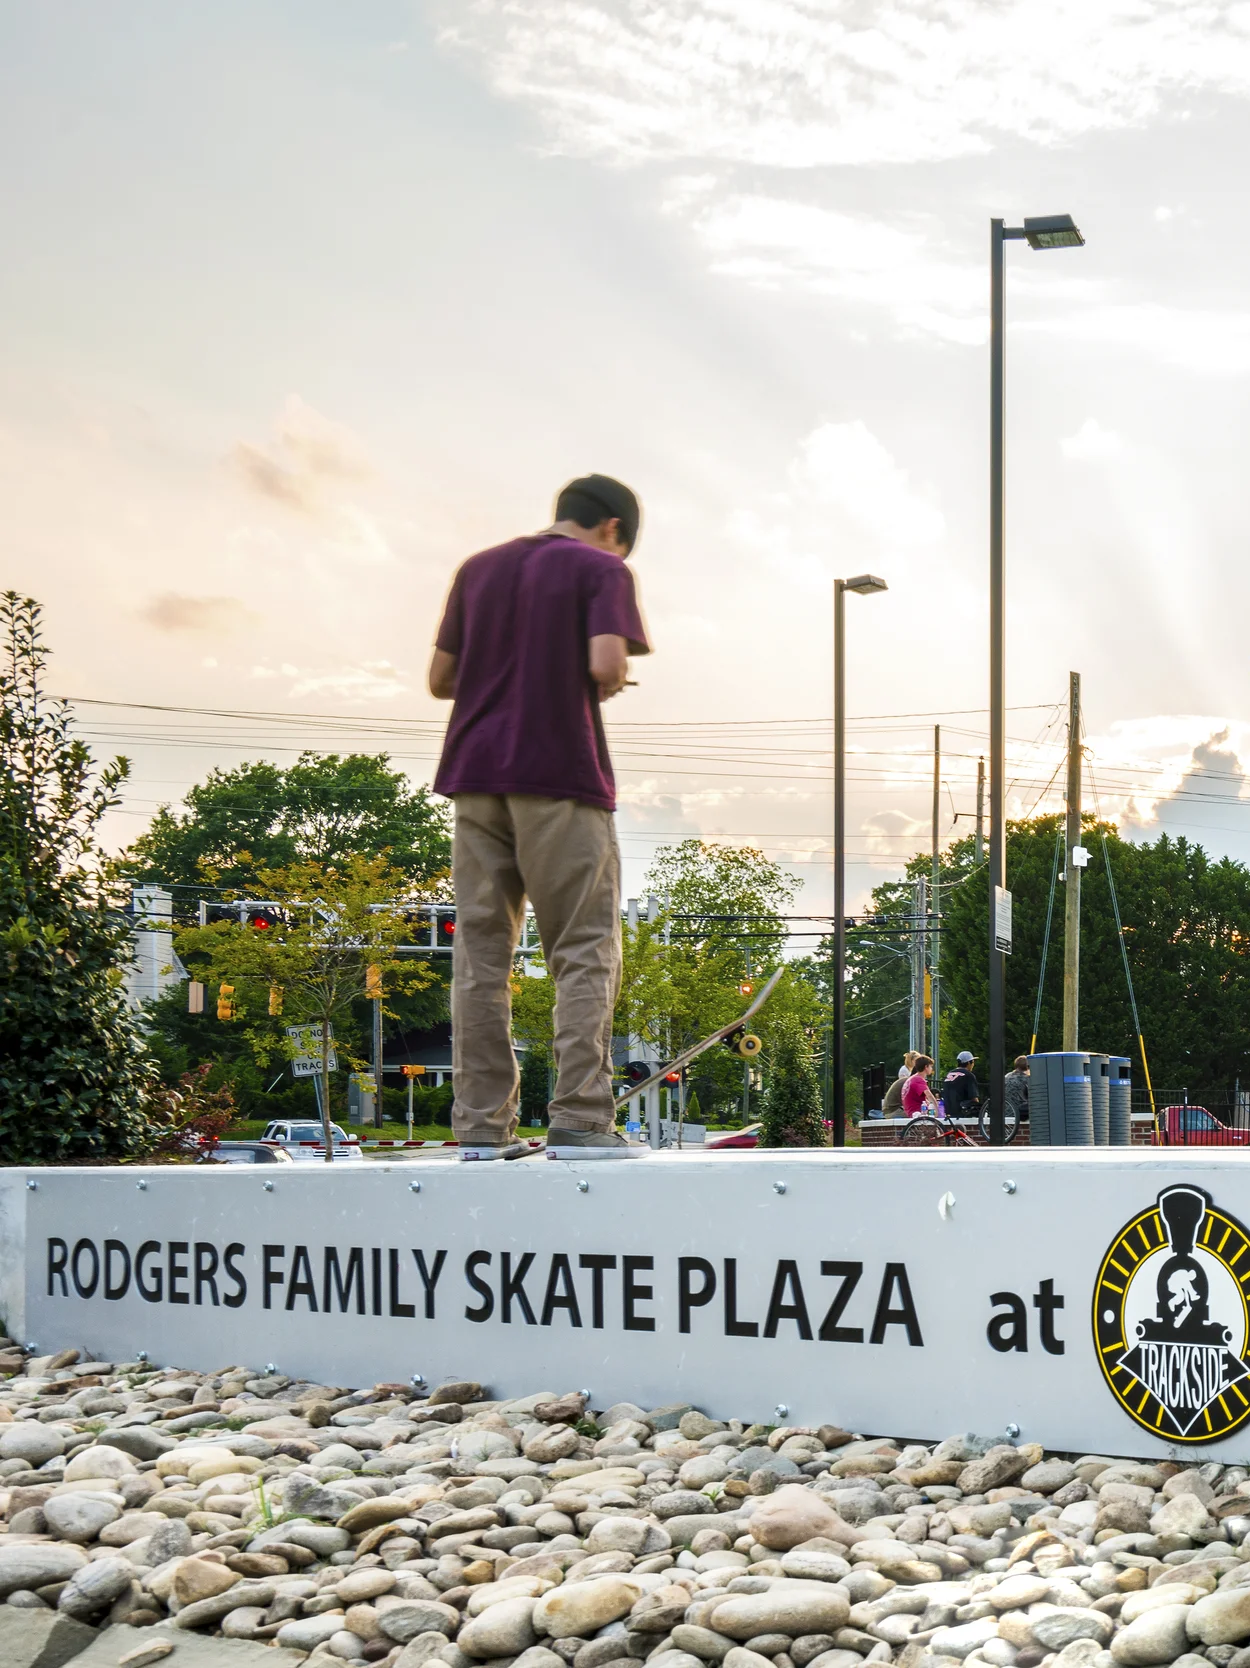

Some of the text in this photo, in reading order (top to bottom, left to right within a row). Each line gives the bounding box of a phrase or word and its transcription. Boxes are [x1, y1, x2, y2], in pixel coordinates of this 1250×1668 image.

[296, 1060, 334, 1071] TRACS
[47, 1237, 1065, 1356] RODGERS FAMILY SKATE PLAZA at
[1138, 1343, 1230, 1410] TRACKSIDE
